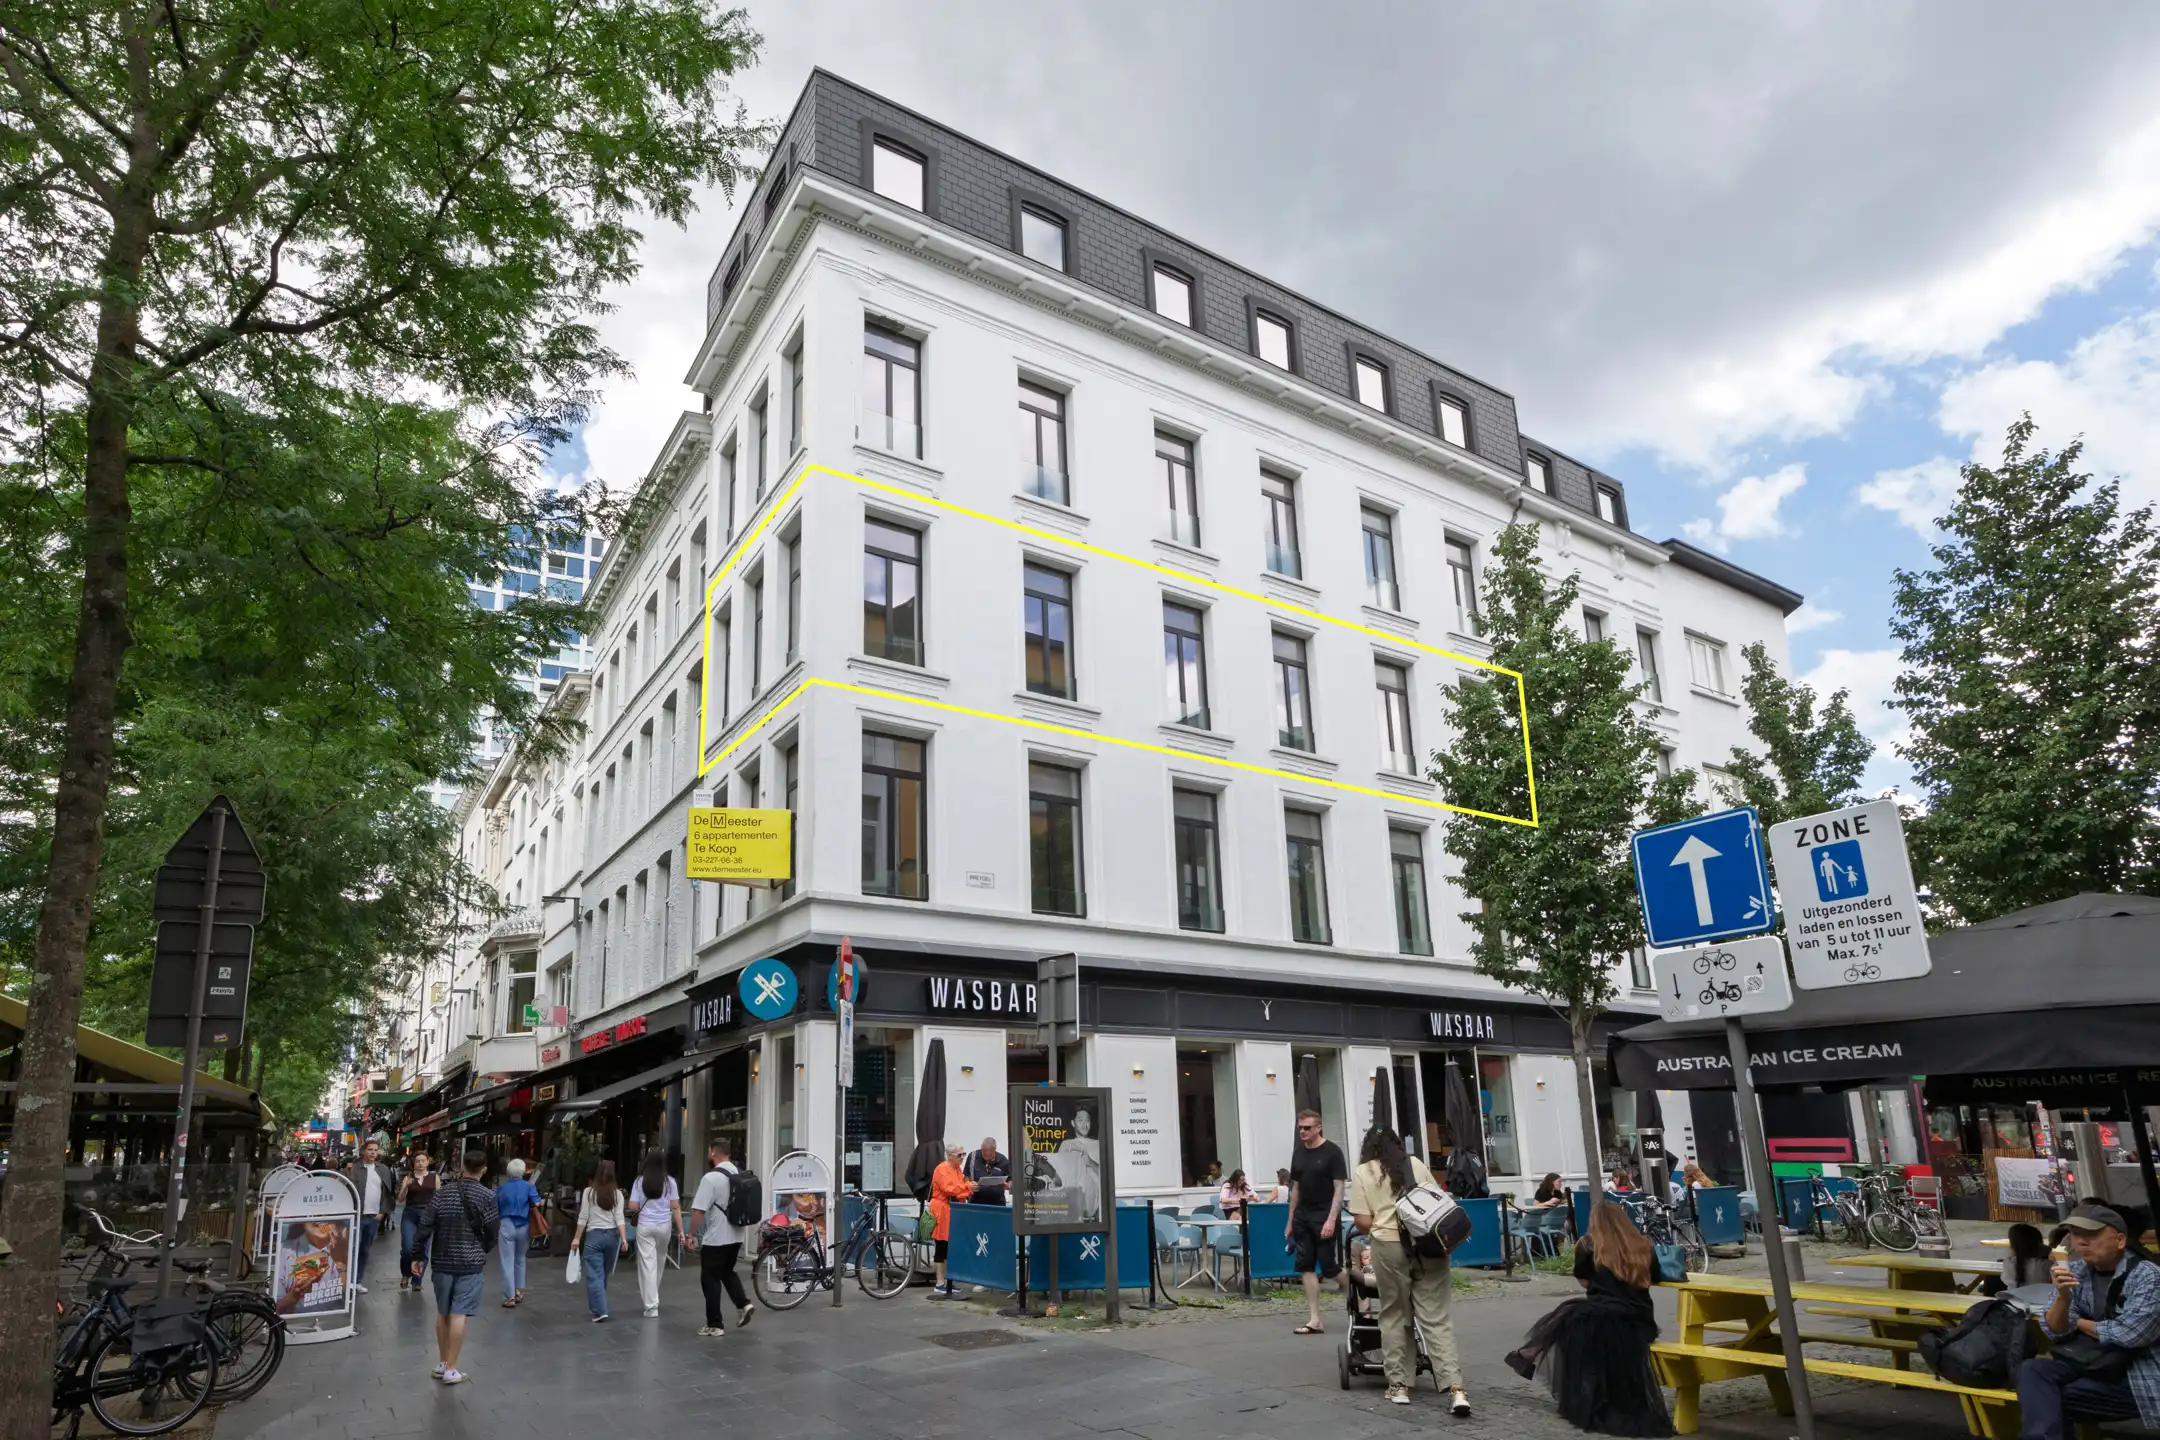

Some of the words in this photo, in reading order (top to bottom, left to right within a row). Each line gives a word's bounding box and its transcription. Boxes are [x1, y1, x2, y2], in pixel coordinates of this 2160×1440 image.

[693, 815, 709, 826] De
[711, 813, 763, 827] Meester
[693, 831, 701, 840] 6
[702, 831, 778, 841] appartementen
[1794, 814, 1870, 848] ZONE
[693, 843, 706, 853] Te
[708, 843, 737, 856] Koop
[692, 855, 743, 864] 03-227-06-36
[692, 866, 762, 874] www.demeester.eu
[1802, 894, 1893, 919] Uitgezonderd
[1799, 920, 1835, 935] laden
[1838, 918, 1854, 929] en
[1856, 911, 1903, 927] lossen
[1796, 938, 1820, 950] van
[1827, 934, 1837, 946] 5
[1839, 935, 1848, 944] u
[1851, 929, 1870, 943] tot
[1873, 927, 1885, 939] 11
[1887, 925, 1912, 938] uur
[1827, 948, 1860, 961] Max.
[930, 977, 1037, 1014] WASBAR
[694, 994, 732, 1032] WASBAR
[1720, 1004, 1728, 1013] P
[1430, 1012, 1494, 1039] WASBAR
[1656, 1051, 1778, 1072] AUSTRAAN
[1783, 1048, 1818, 1064] ICE
[1822, 1042, 1903, 1062] CREAM
[1972, 1072, 2084, 1089] AUSTRALIAN
[2089, 1071, 2121, 1085] ICE
[1025, 1099, 1053, 1113] Niall
[1025, 1112, 1062, 1126] Horan
[1025, 1125, 1067, 1139] Dinner
[303, 1194, 334, 1203] WASBAR
[312, 1277, 343, 1292] BAGEL
[304, 1286, 343, 1302] BURGER
